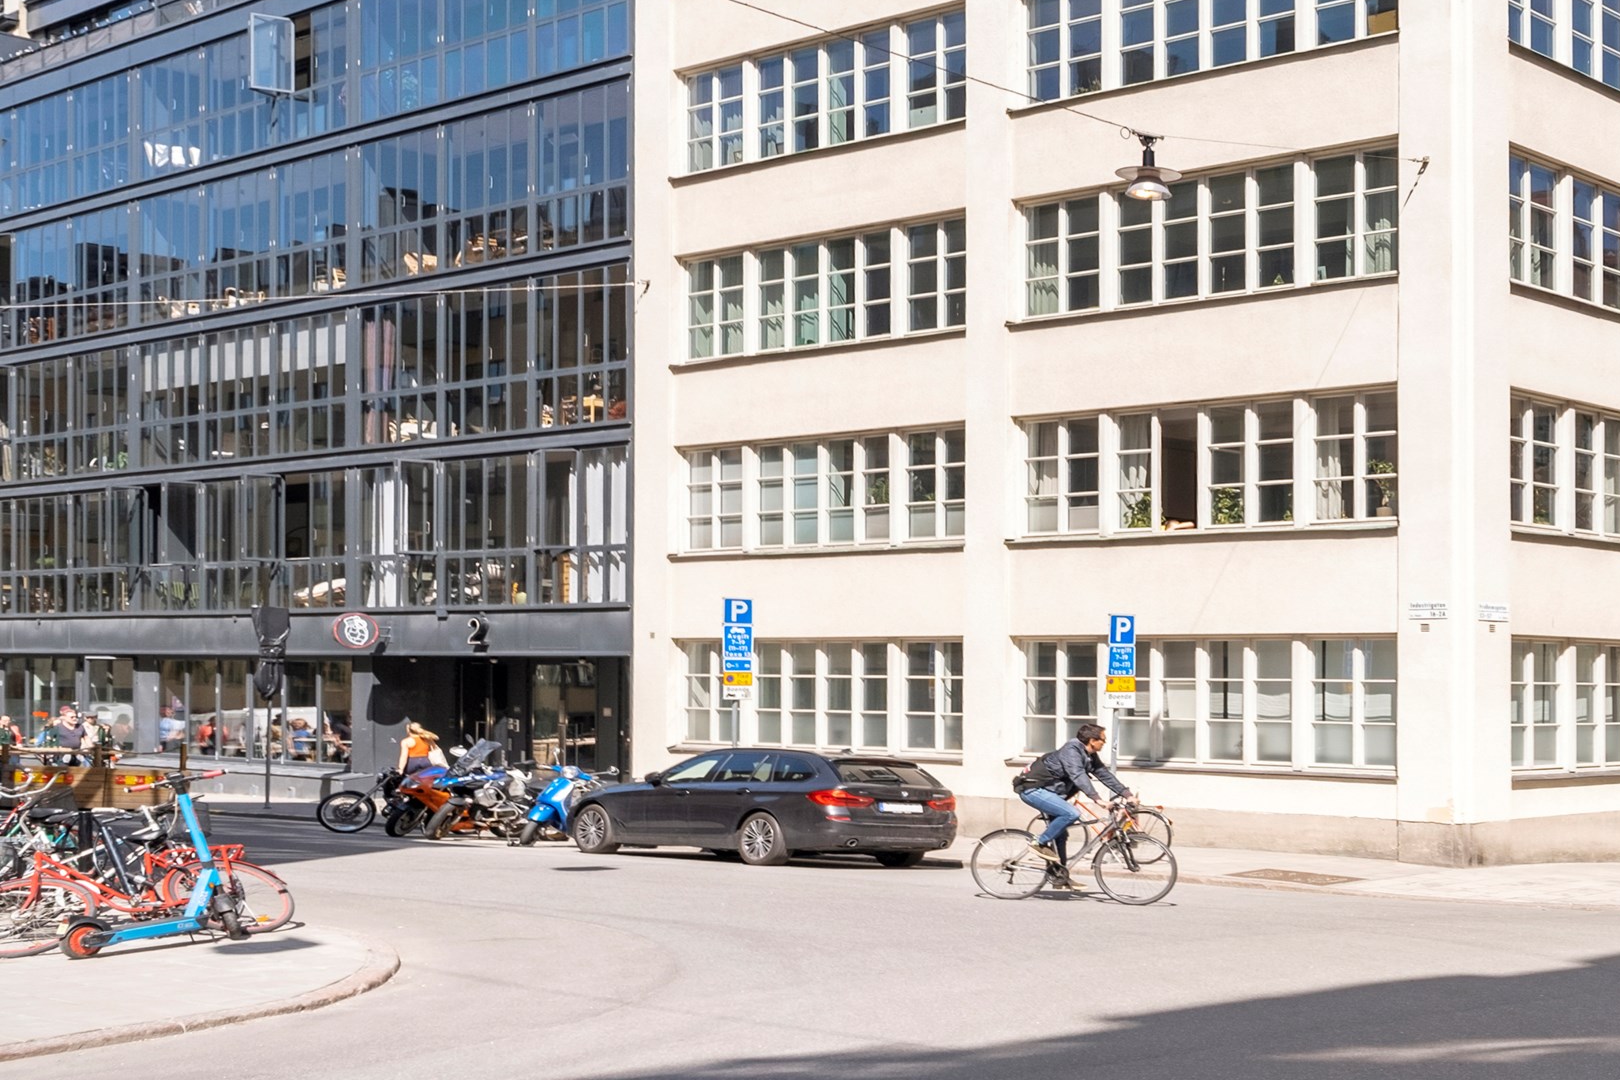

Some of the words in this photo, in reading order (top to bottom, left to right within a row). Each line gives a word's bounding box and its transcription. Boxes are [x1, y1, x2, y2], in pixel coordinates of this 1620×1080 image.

[731, 600, 749, 622] P
[467, 617, 482, 645] 2
[727, 633, 750, 641] Avgift
[1115, 617, 1132, 642] P
